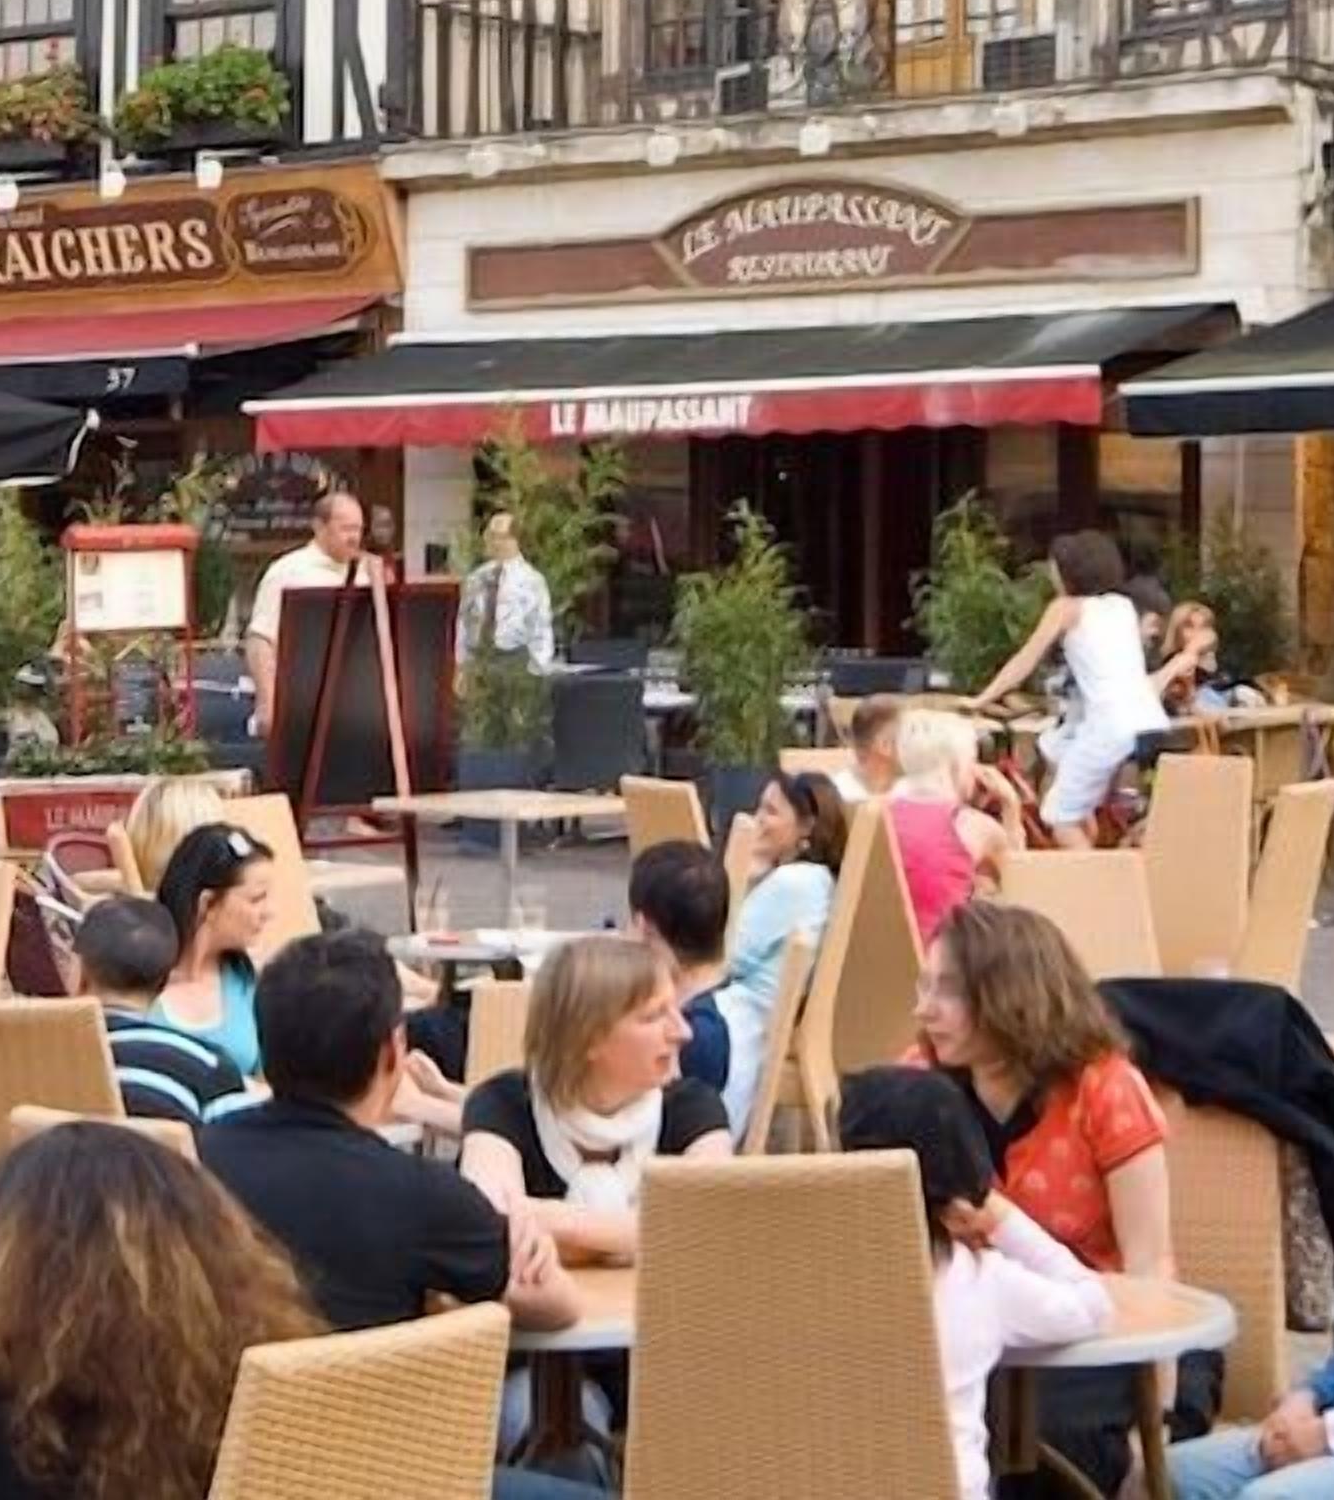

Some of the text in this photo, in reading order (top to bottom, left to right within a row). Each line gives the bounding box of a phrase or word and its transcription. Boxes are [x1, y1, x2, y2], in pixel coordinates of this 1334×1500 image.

[683, 218, 719, 264] LE
[105, 367, 136, 391] 37
[550, 395, 753, 434] LE MAUPASSANT
